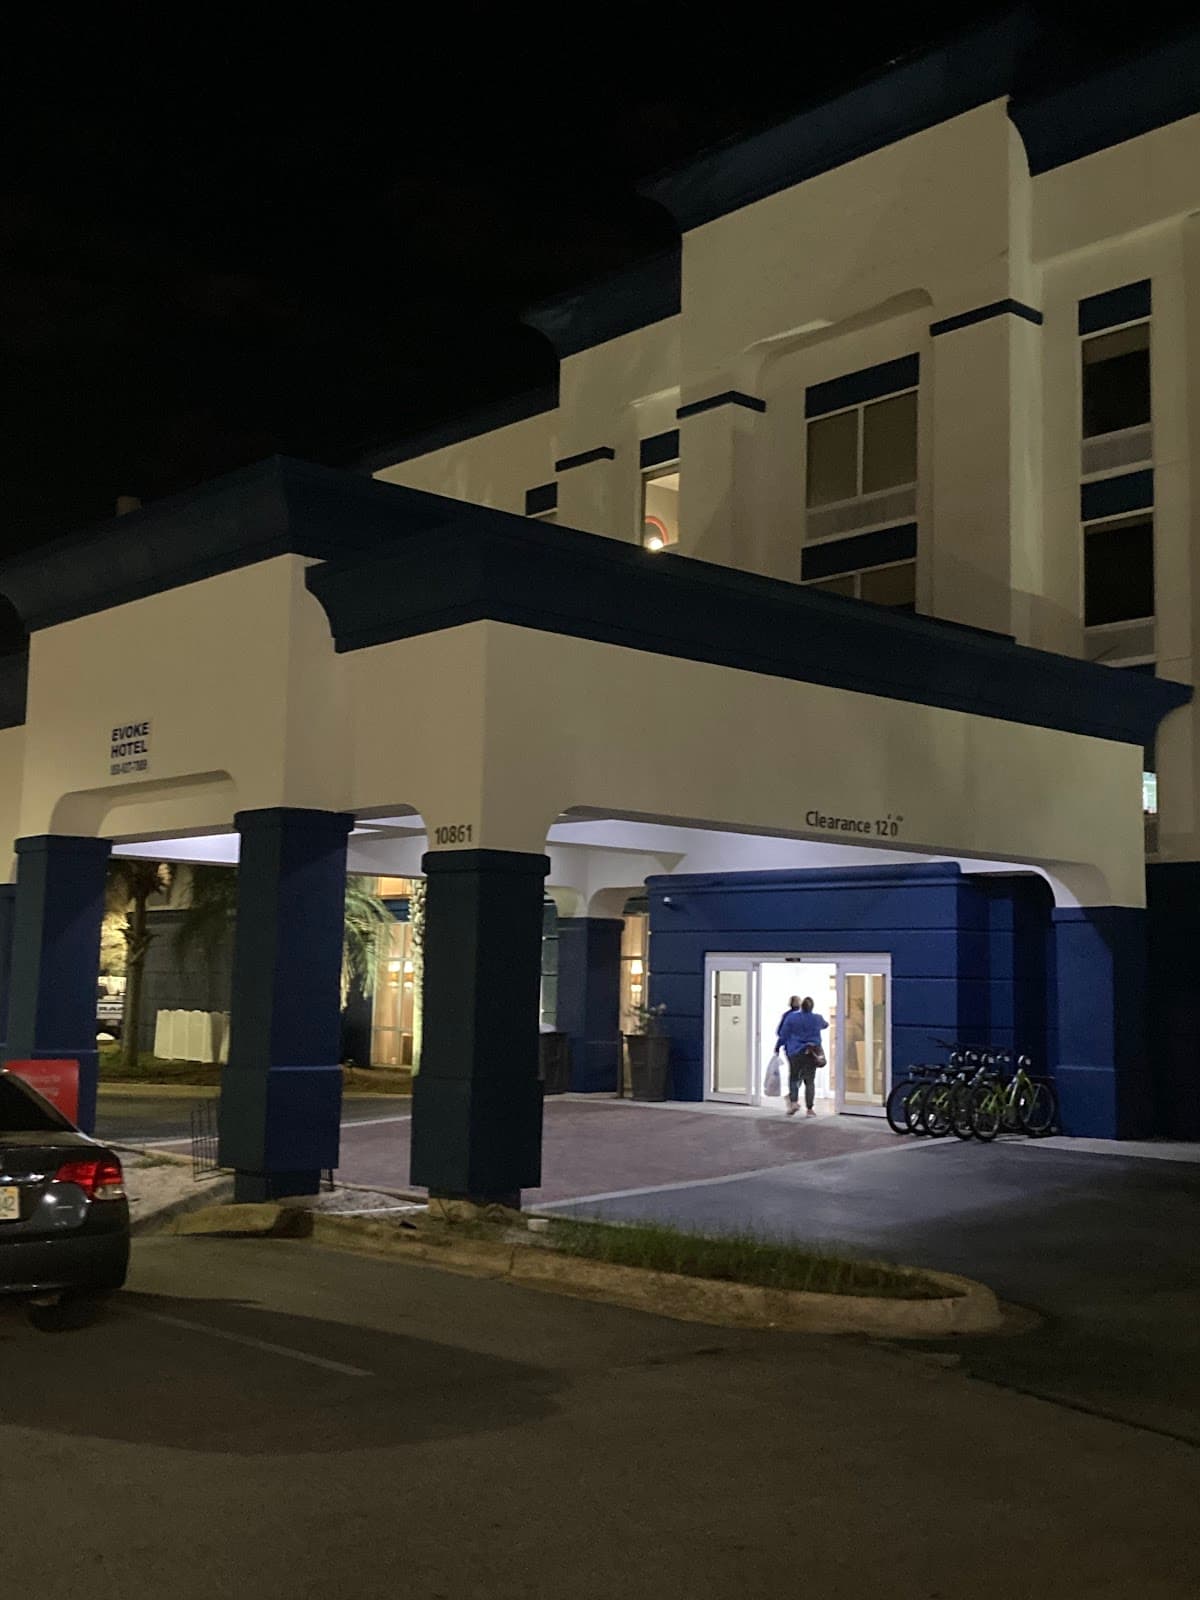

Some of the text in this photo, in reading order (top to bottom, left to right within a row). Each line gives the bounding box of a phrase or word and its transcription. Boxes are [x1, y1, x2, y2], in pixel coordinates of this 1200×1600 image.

[112, 722, 149, 742] EVOKE
[111, 740, 148, 759] HOTEL
[806, 811, 871, 833] Clearance
[435, 824, 473, 845] 10861
